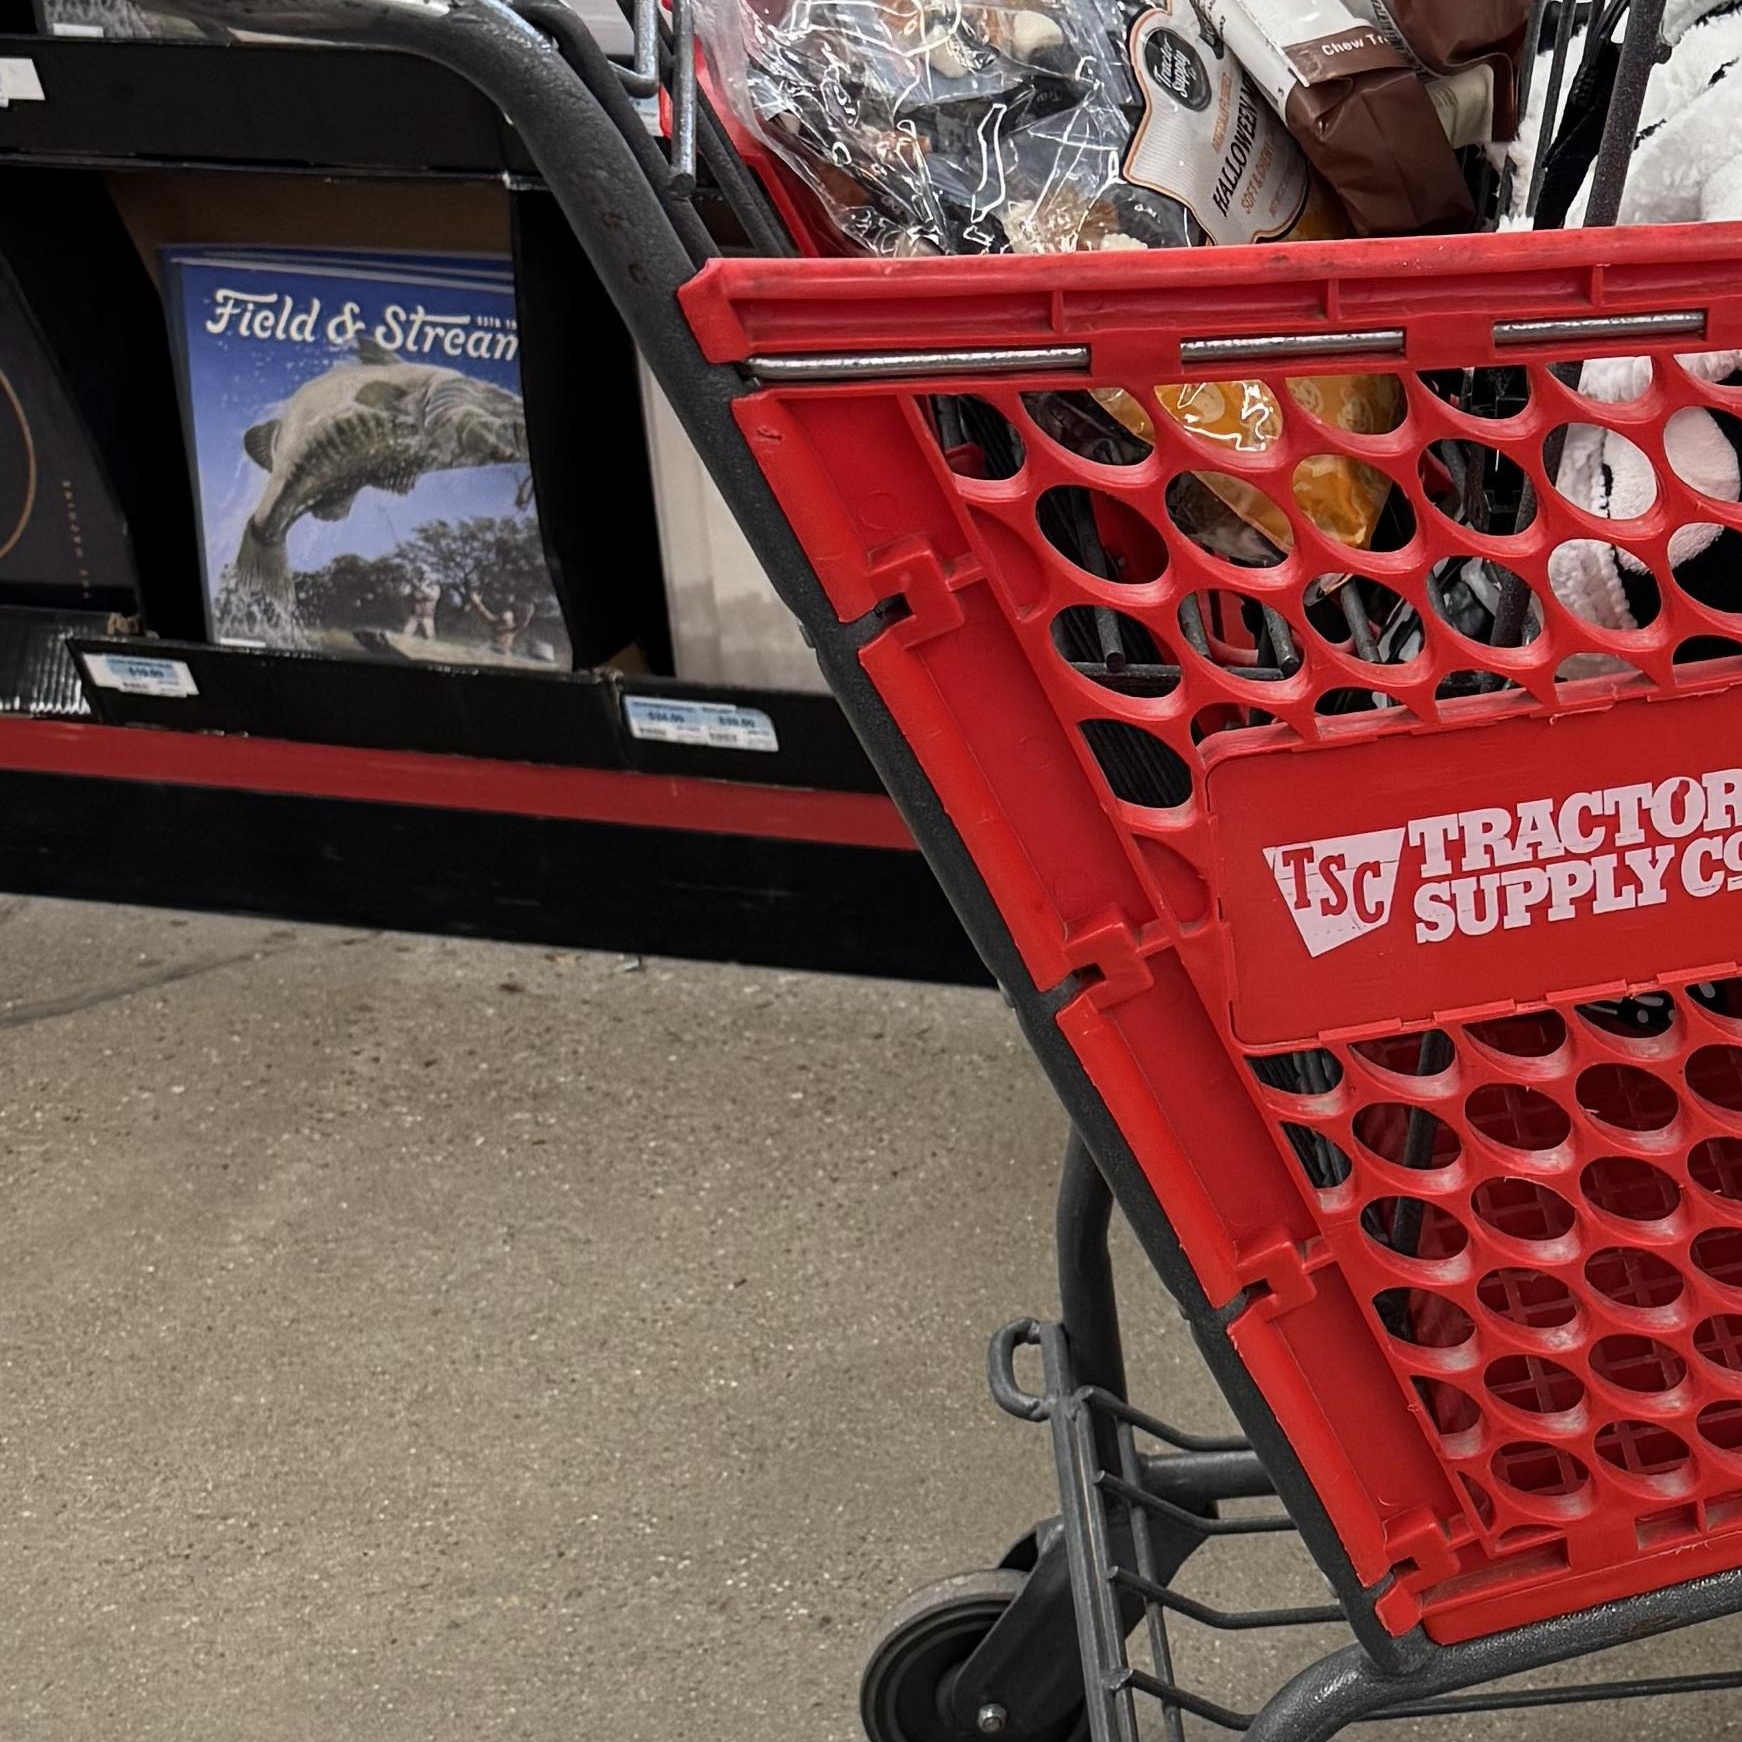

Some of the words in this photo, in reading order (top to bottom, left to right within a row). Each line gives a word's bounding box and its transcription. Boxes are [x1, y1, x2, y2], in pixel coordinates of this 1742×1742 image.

[1172, 49, 1191, 98] Supply
[1322, 39, 1364, 56] Chew
[1212, 95, 1258, 218] HALLOWEEN
[206, 288, 321, 343] Field
[327, 302, 365, 345] &
[1281, 847, 1387, 924] TSC
[1414, 844, 1676, 944] SUPPLY
